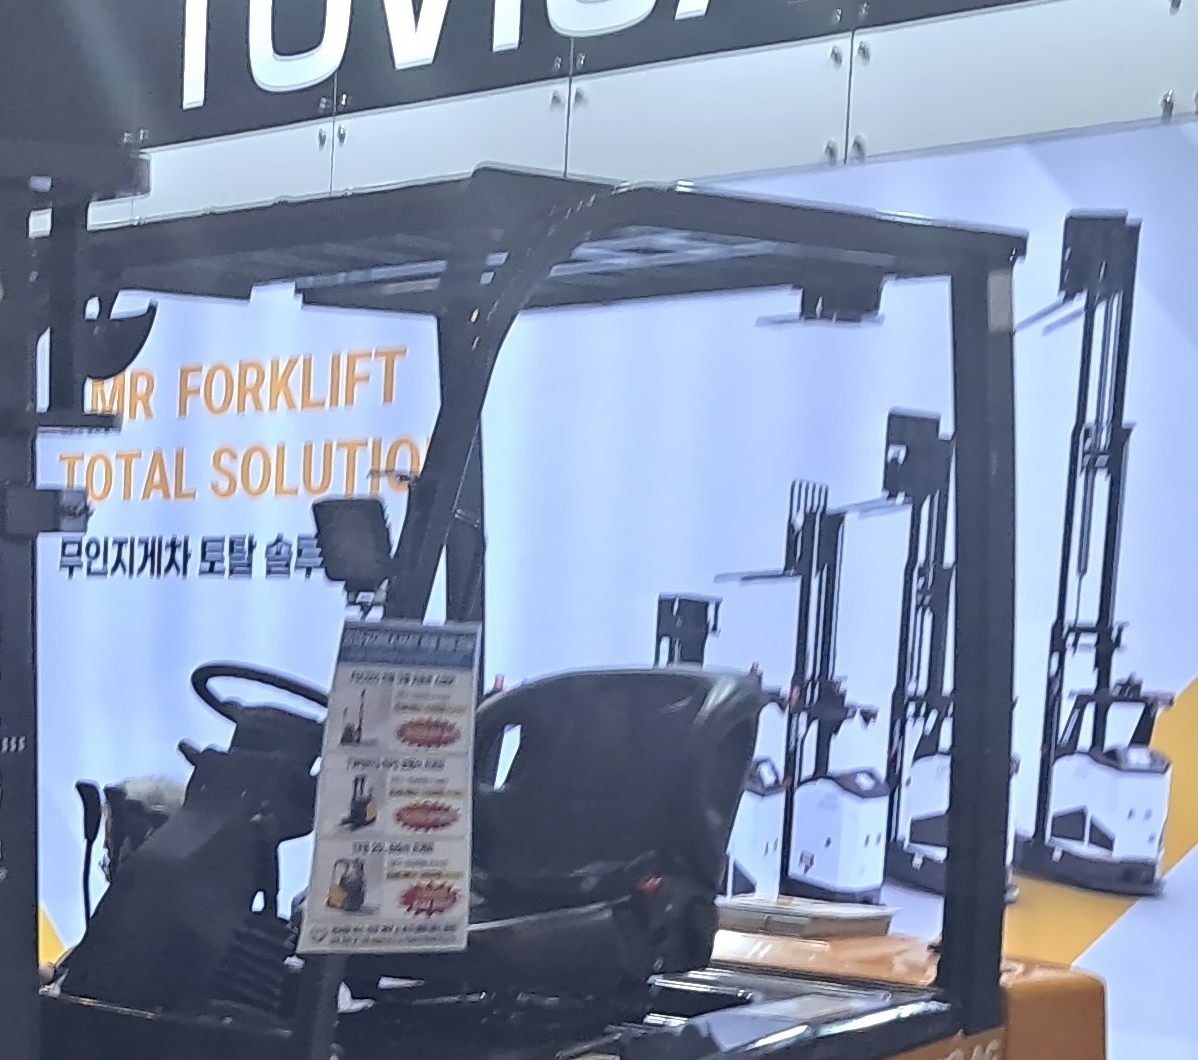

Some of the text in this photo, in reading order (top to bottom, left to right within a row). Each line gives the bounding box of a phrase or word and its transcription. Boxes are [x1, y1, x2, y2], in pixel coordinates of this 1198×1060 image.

[178, 346, 407, 419] FORKLIFT
[59, 435, 430, 502] TOTAL SOLUTIO
[59, 532, 324, 579] 무인지게차 토탈 솔루
